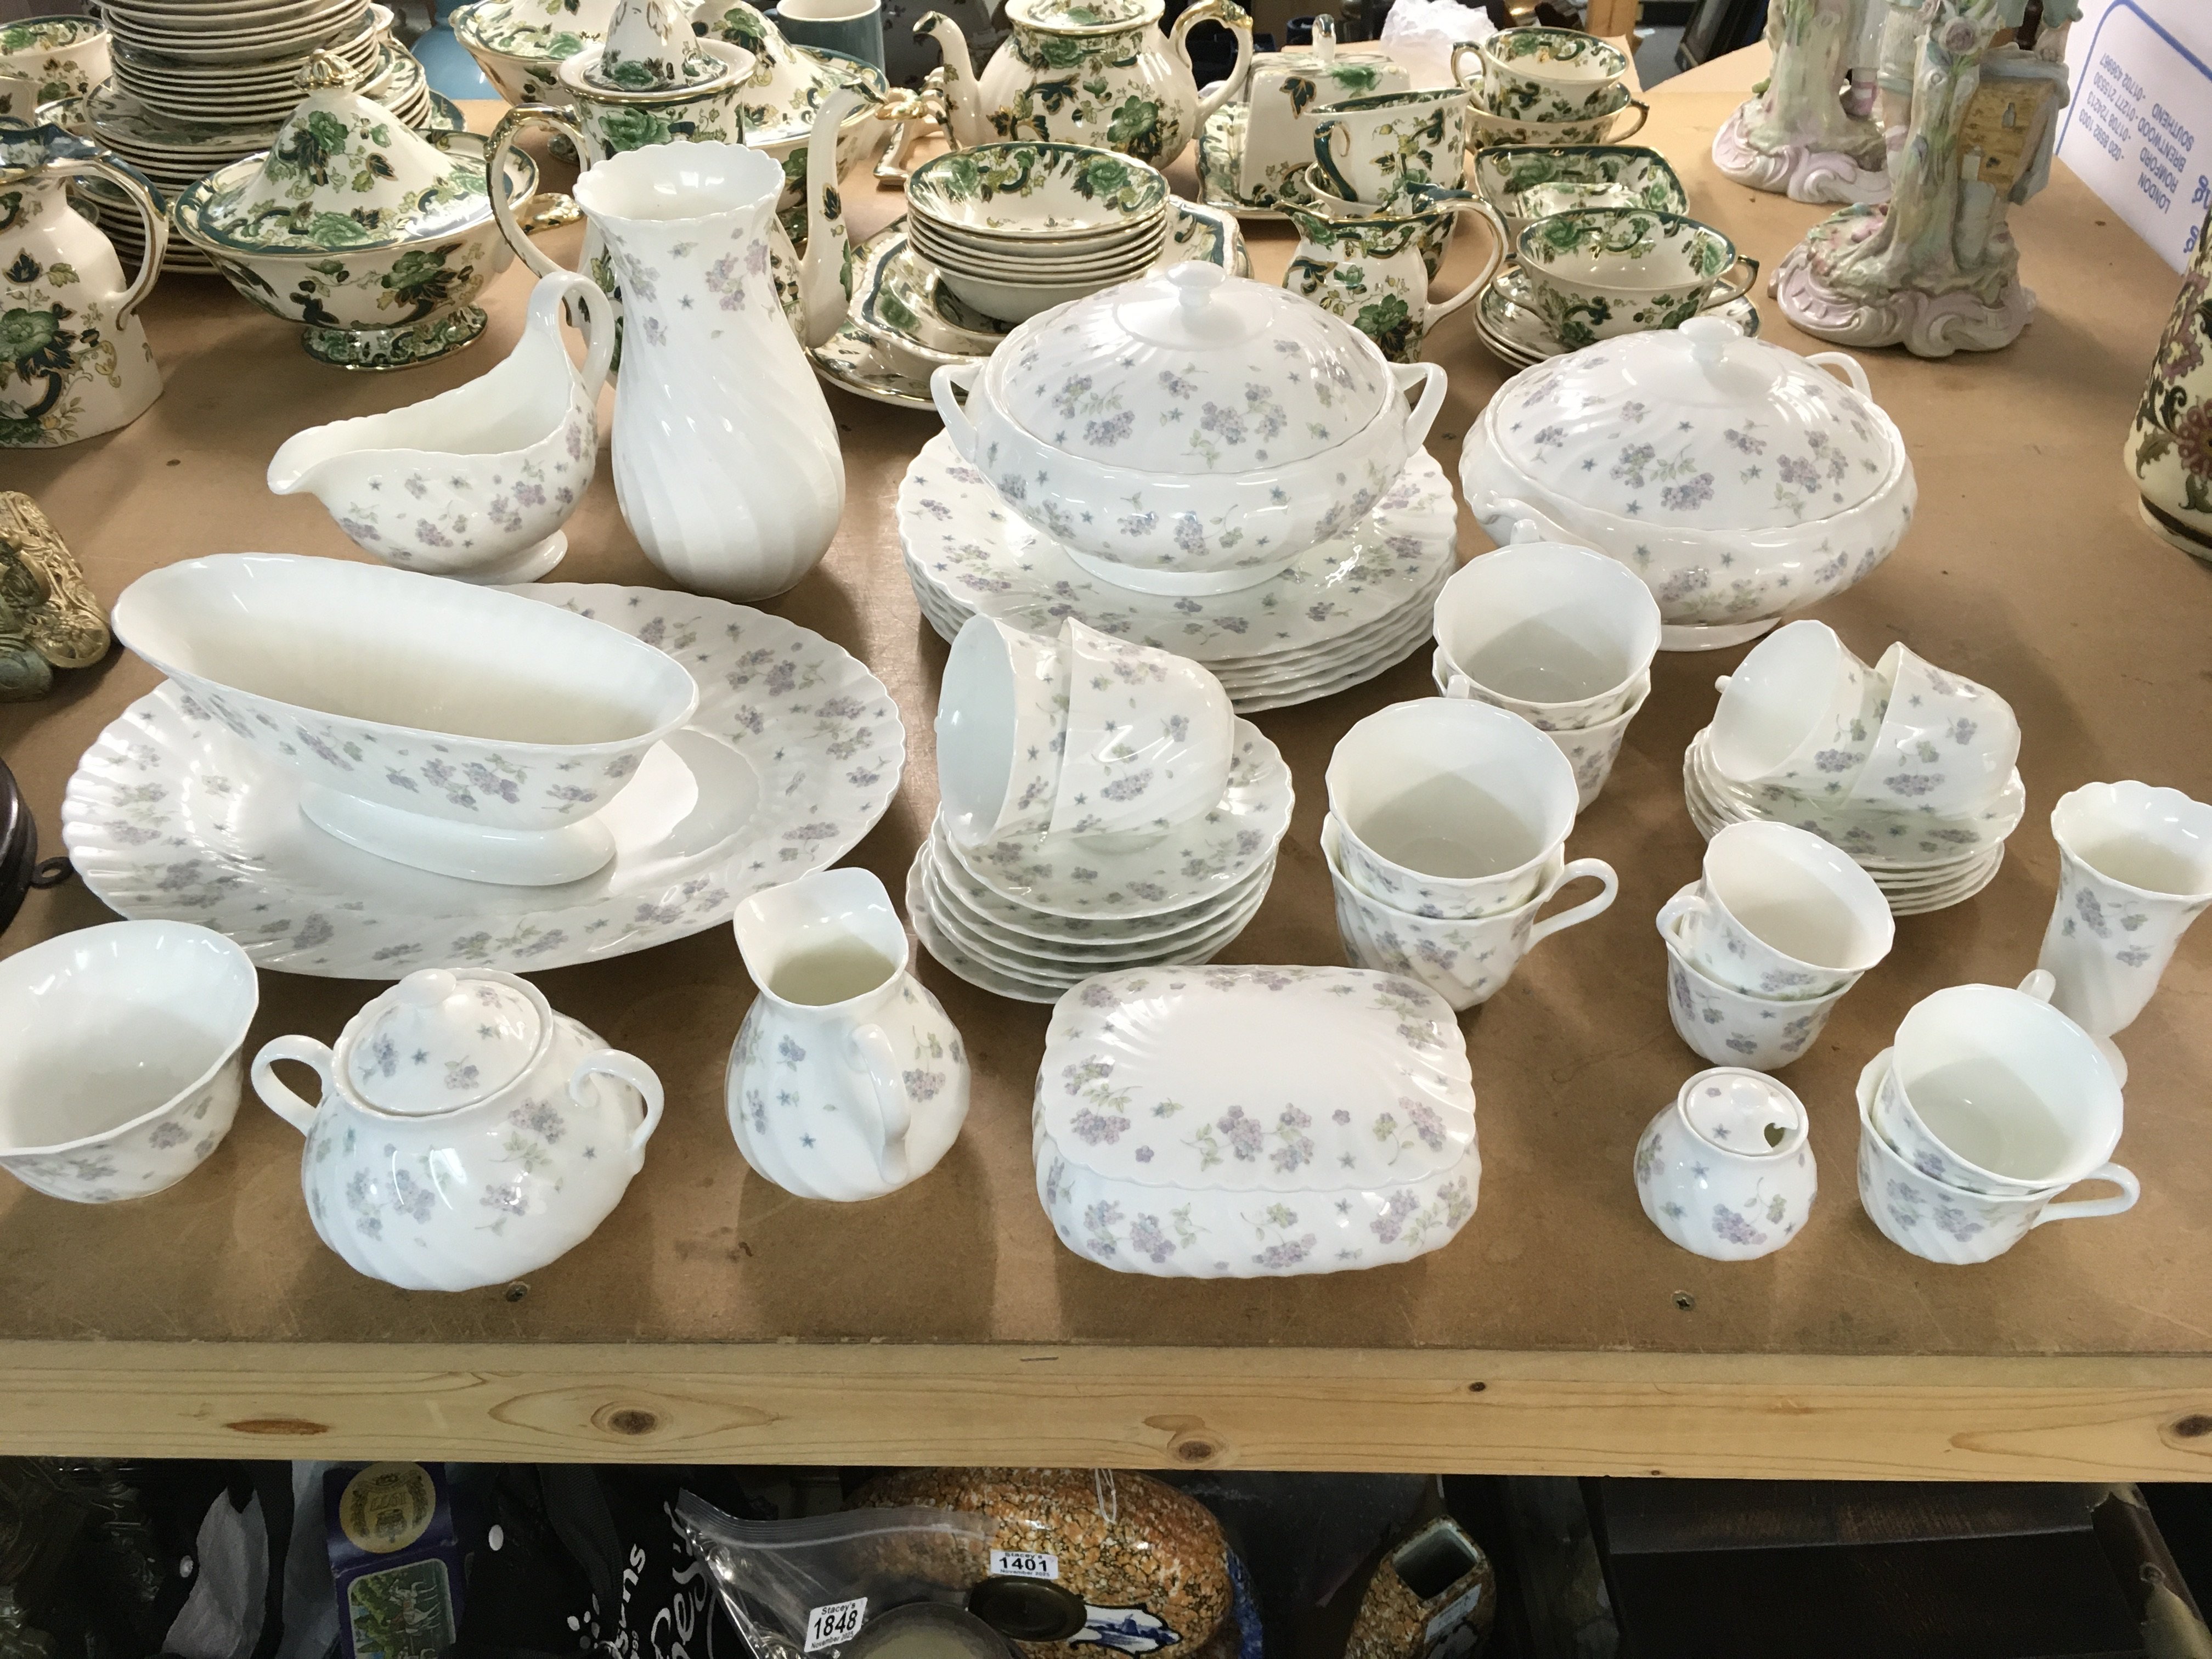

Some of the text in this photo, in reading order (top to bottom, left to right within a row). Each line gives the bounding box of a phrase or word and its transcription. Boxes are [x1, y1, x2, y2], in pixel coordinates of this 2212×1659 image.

[2094, 71, 2117, 102] 215530
[2079, 109, 2094, 131] 1003
[2087, 91, 2109, 122] 724213
[2152, 103, 2194, 152] SOUTHEND
[2137, 117, 2187, 173] BRENTWOOD
[2140, 146, 2179, 193] ROMFORD
[2138, 172, 2171, 215] LONDON
[999, 1557, 1047, 1572] 1401
[821, 1602, 856, 1615] Stacey's
[814, 1610, 858, 1640] 1848
